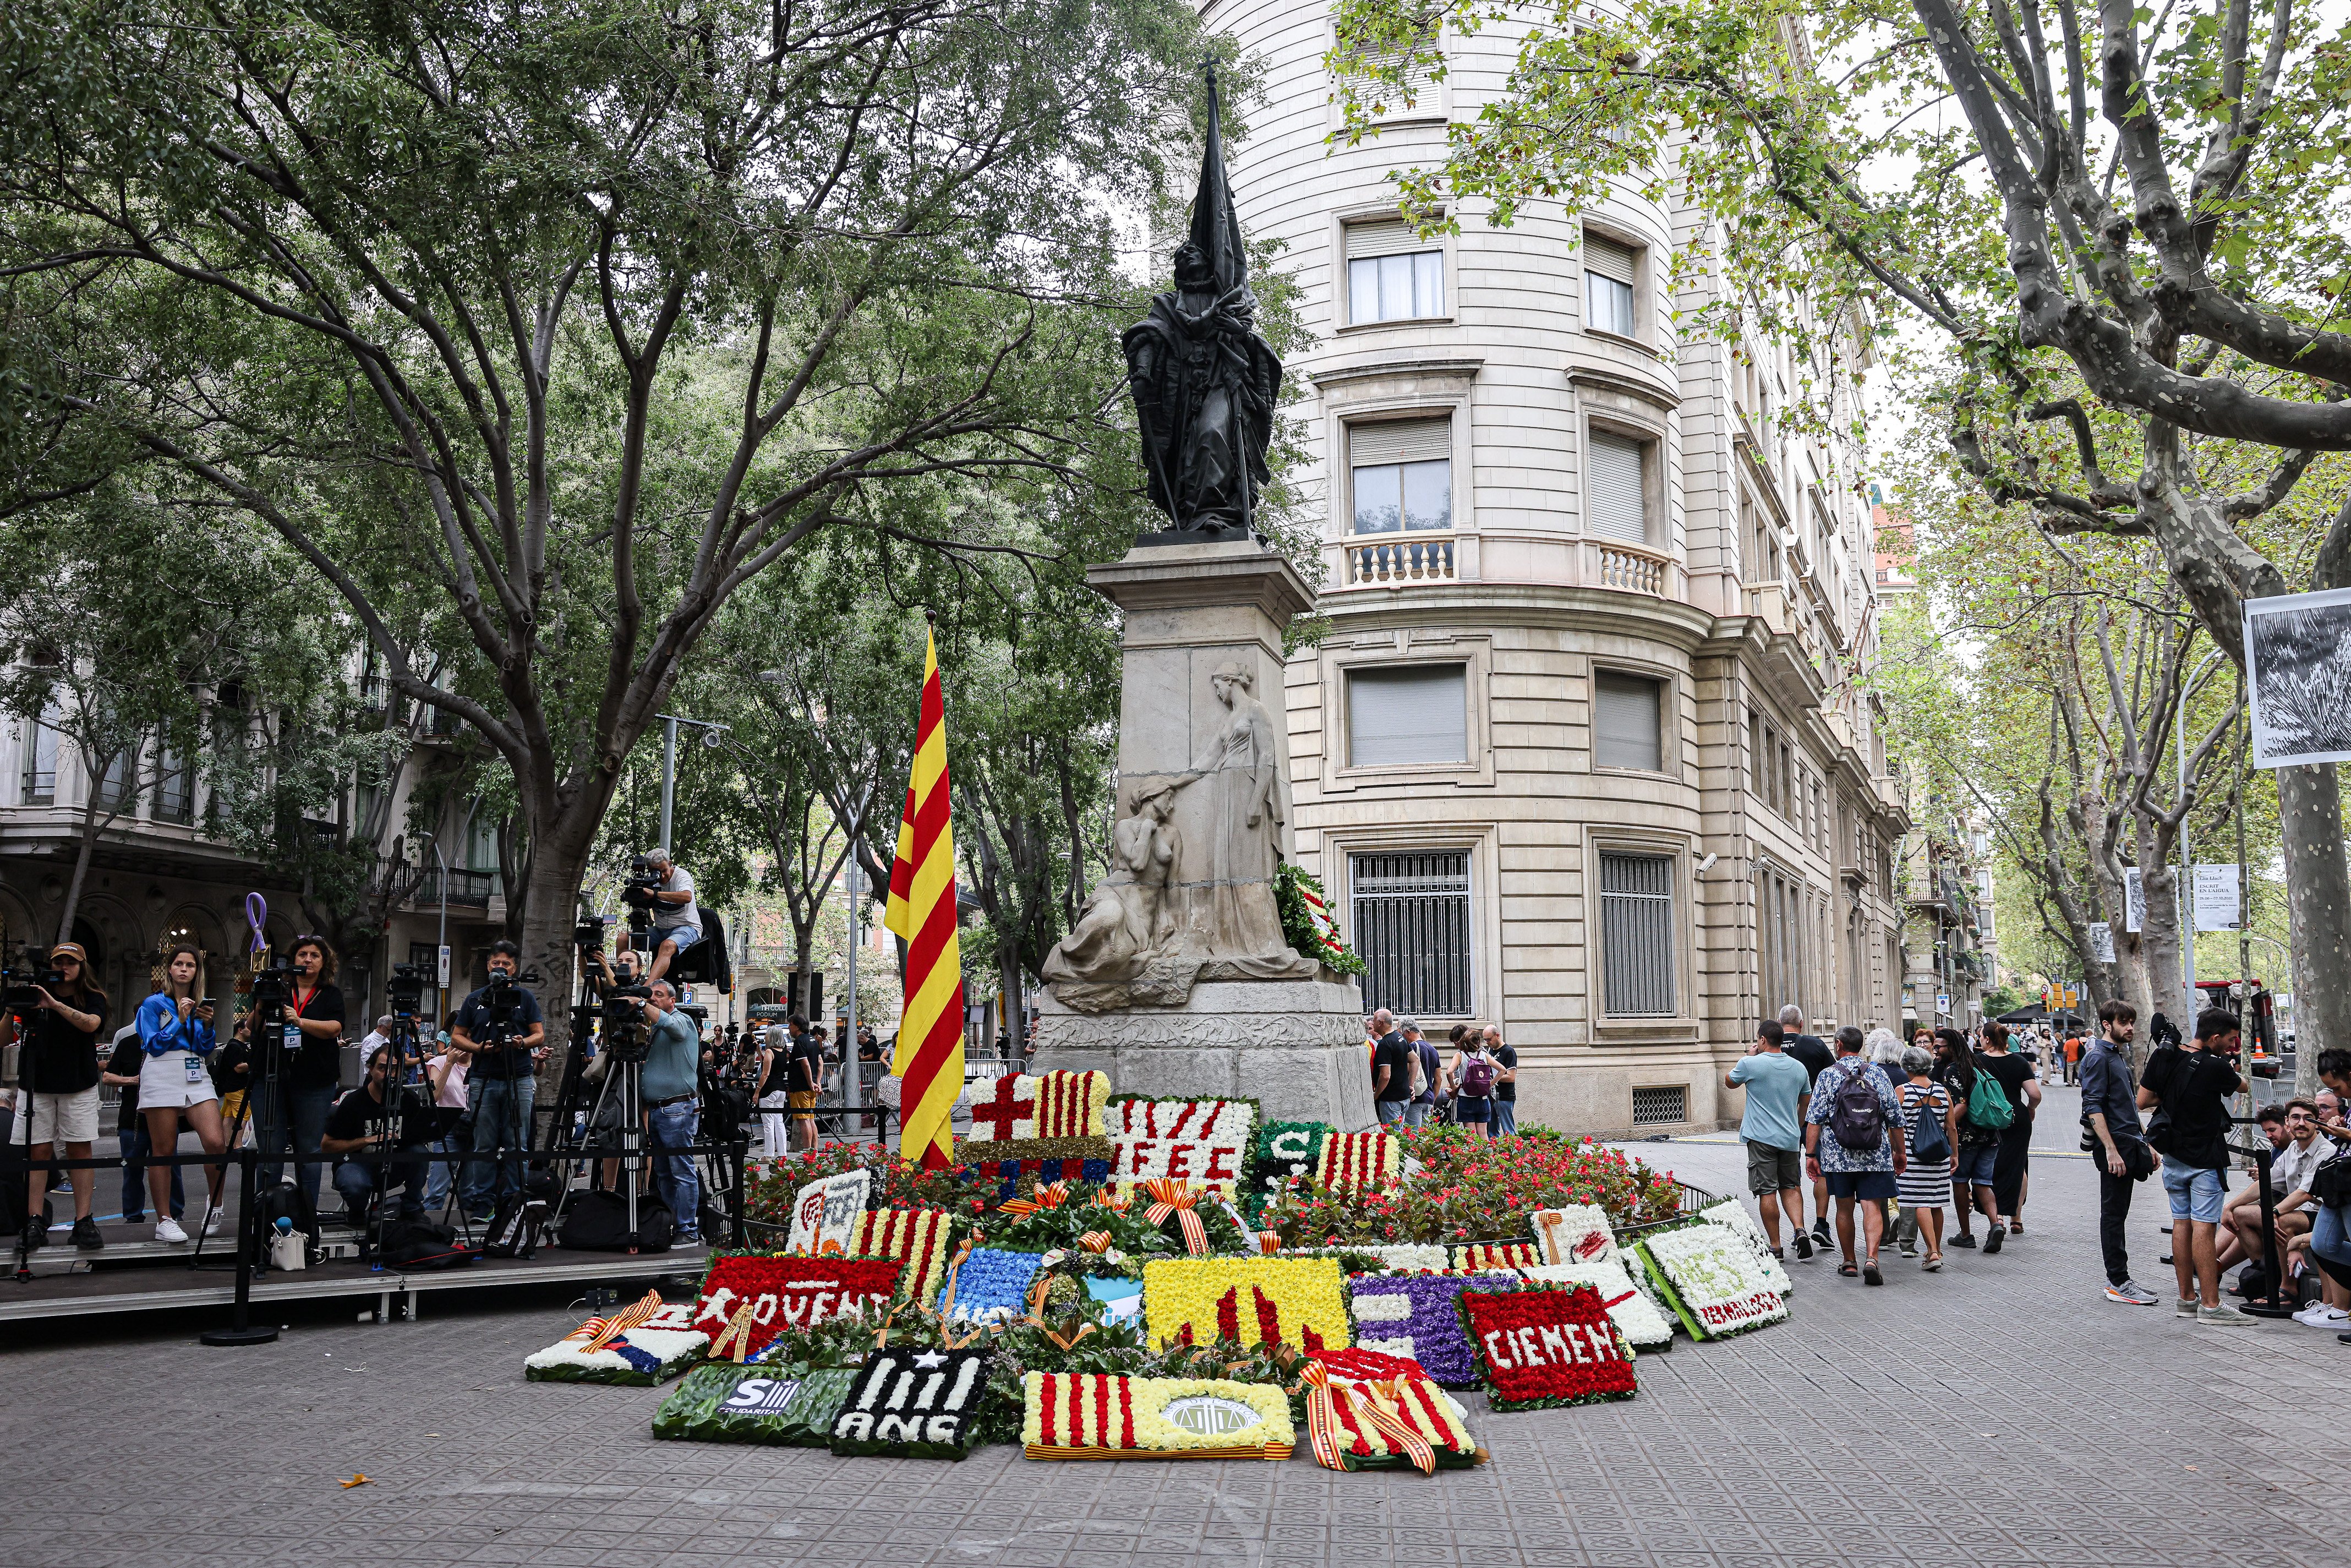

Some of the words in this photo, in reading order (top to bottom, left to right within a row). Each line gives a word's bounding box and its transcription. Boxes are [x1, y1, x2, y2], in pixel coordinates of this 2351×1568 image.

[685, 993, 691, 1004] P
[1484, 1320, 1619, 1370] CIEMEN
[835, 1411, 961, 1446] ANC
